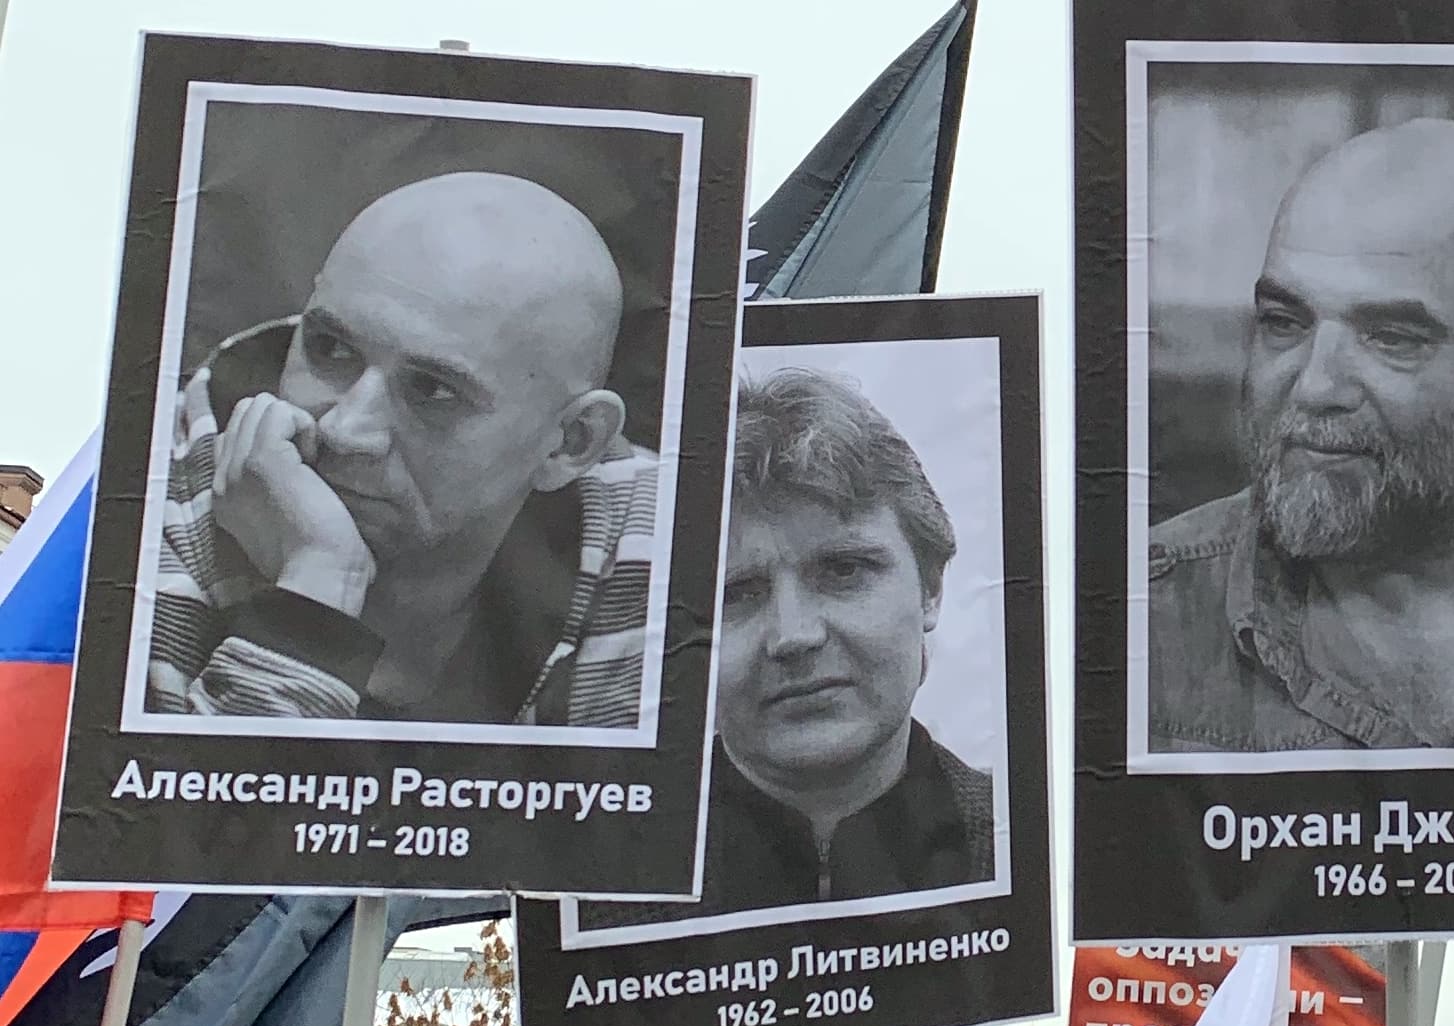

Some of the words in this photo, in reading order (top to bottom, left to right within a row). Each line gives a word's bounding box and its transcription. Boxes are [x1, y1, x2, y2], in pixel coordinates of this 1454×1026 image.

[110, 758, 379, 815] Александр
[390, 767, 653, 822] Расторгуев
[294, 822, 360, 856] 1971
[394, 825, 470, 857] 2018
[1203, 805, 1361, 861] Орхан
[1314, 863, 1387, 897] 1966
[566, 958, 778, 1009] Александр
[787, 928, 1010, 979] Литвиненко
[805, 988, 874, 1019] 2006
